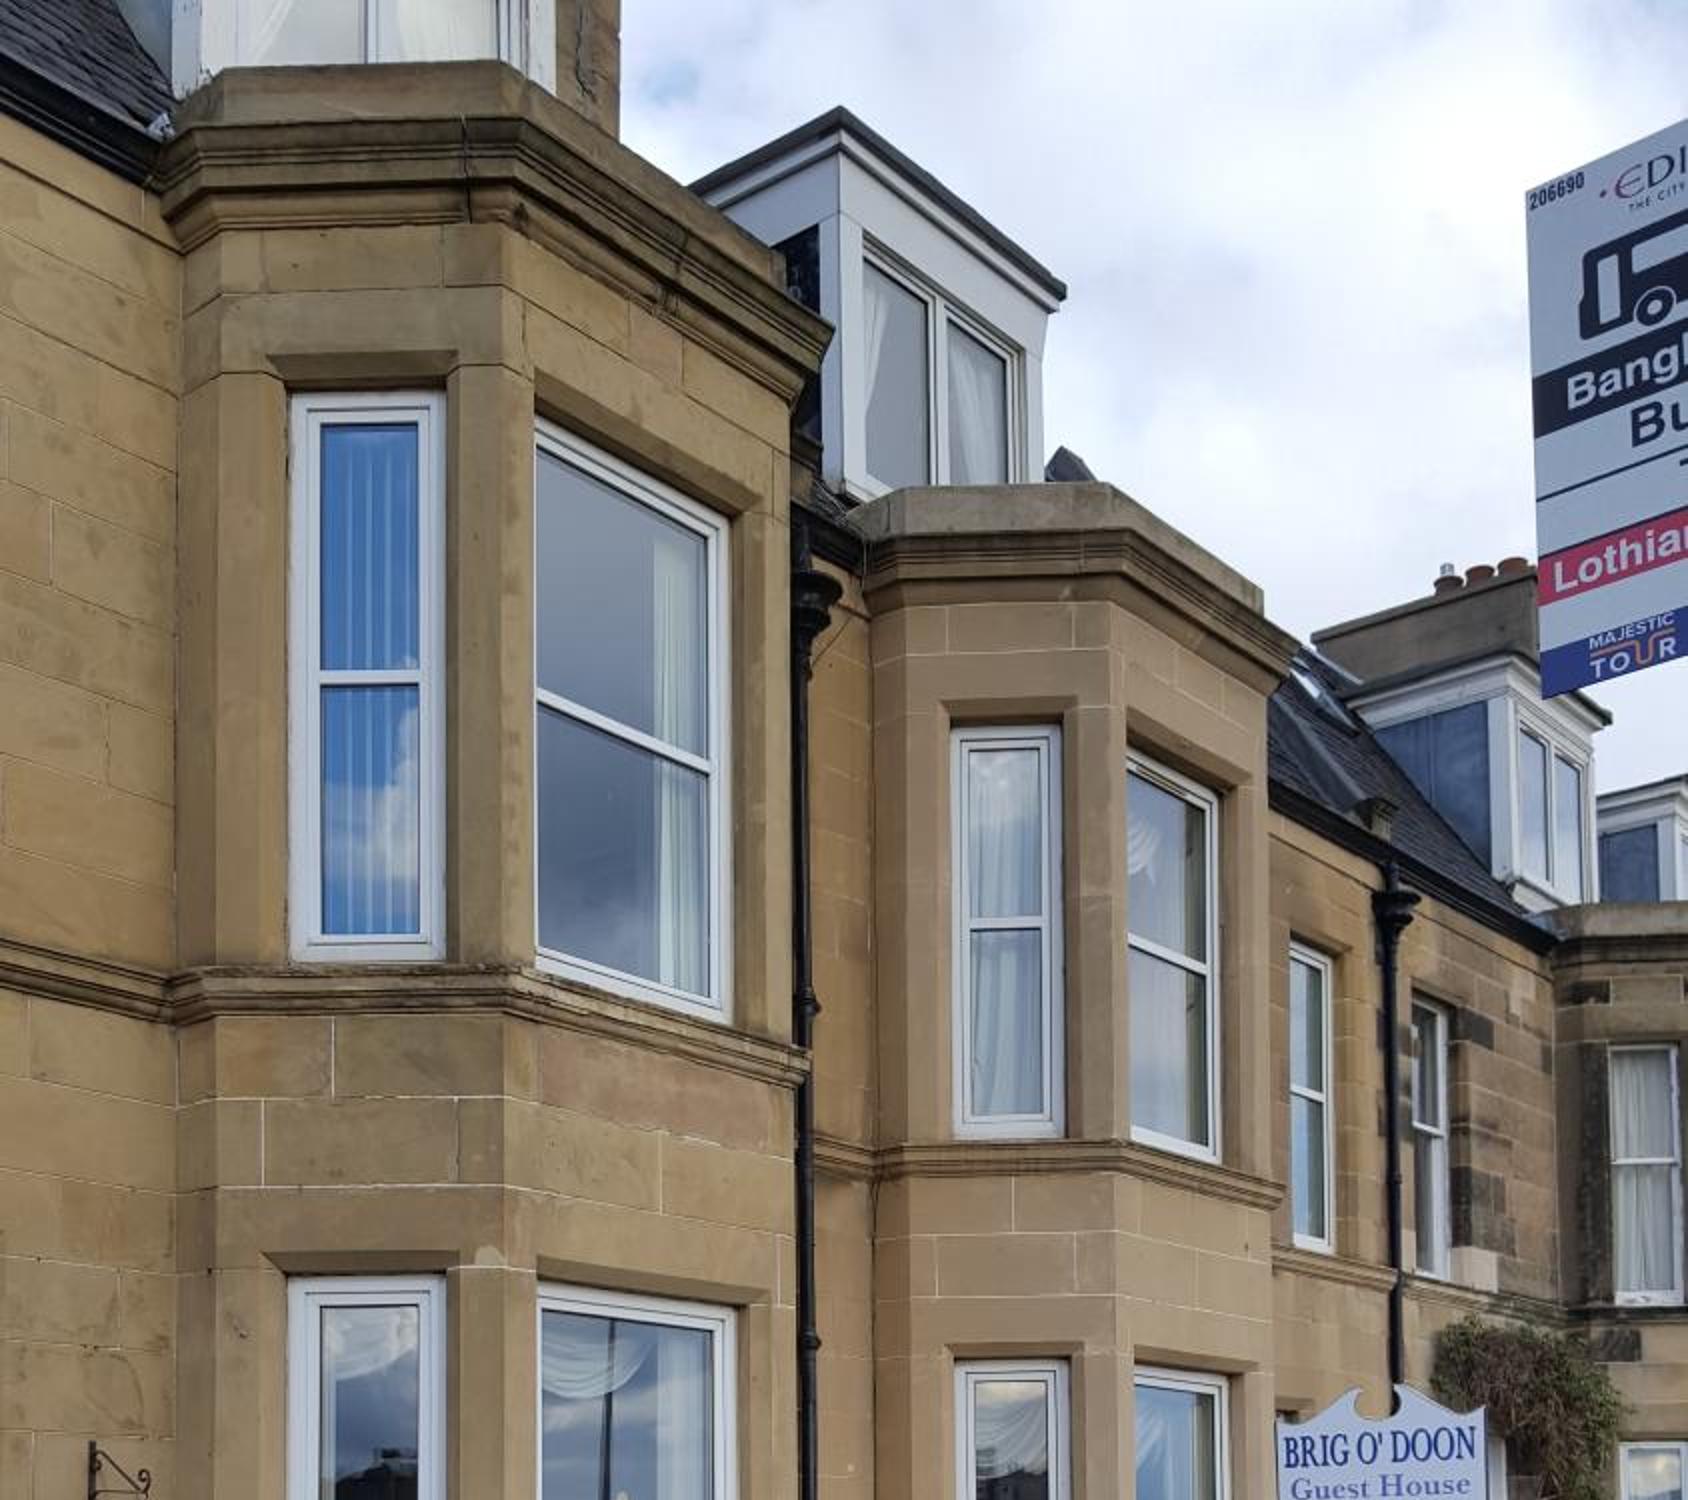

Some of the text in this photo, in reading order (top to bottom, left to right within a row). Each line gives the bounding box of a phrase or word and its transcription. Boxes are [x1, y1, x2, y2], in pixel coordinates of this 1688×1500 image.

[1530, 171, 1585, 211] 206690
[1589, 612, 1675, 650] MAJESTIC
[1589, 636, 1677, 679] TOUR
[1284, 1433, 1349, 1468] BRIG
[1390, 1425, 1476, 1463] DOON
[1291, 1473, 1471, 1500] Guest House
